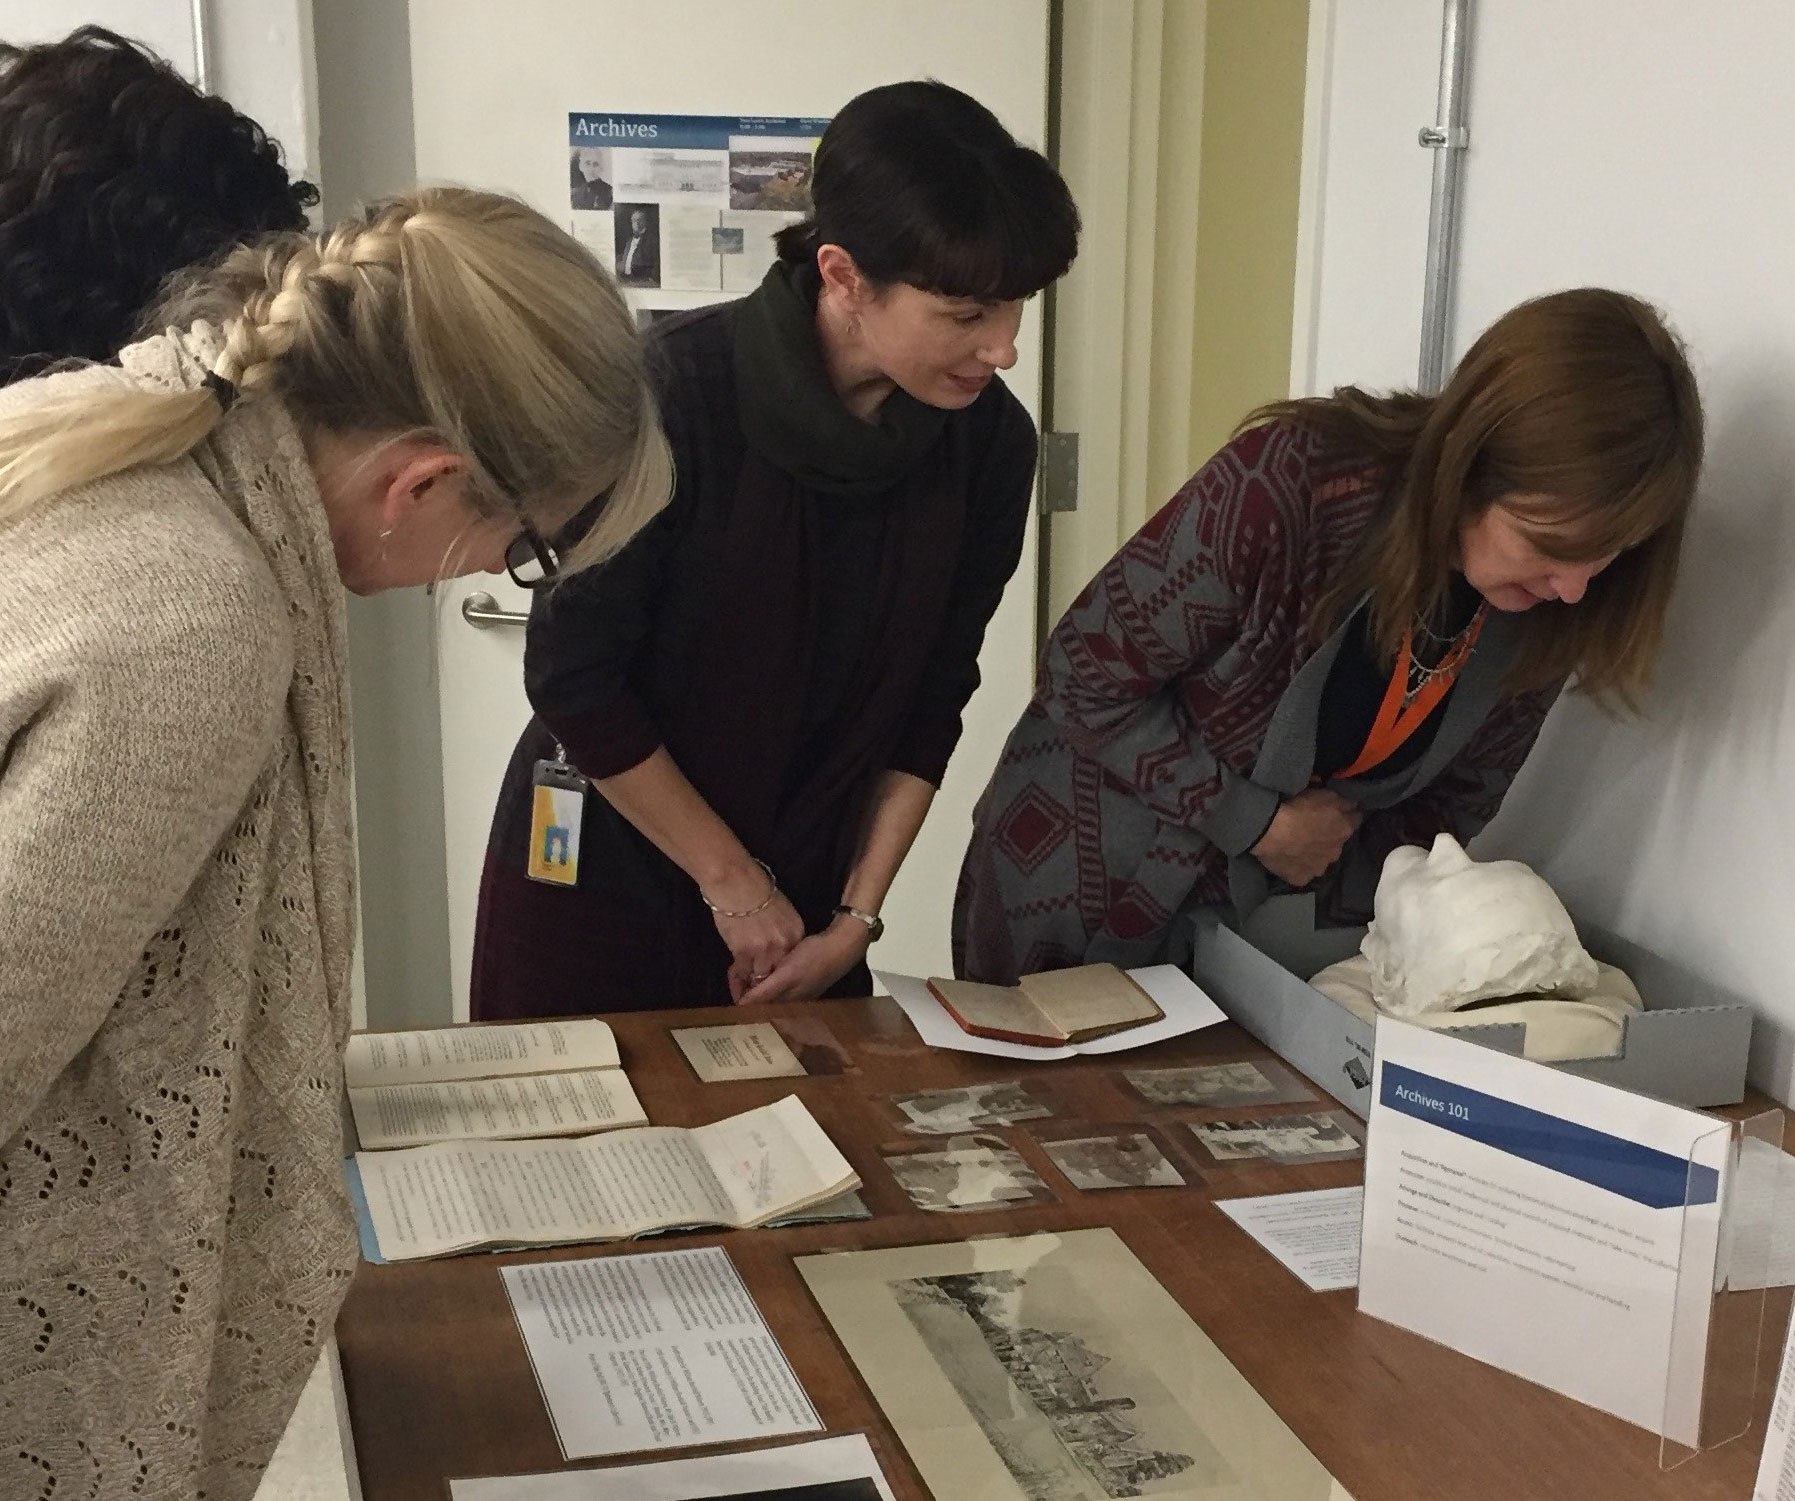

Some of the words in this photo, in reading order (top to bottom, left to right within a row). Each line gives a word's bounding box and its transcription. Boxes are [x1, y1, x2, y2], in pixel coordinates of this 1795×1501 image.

[575, 118, 658, 138] Archives
[1395, 1084, 1445, 1113] Archives
[1447, 1102, 1470, 1121] 101
